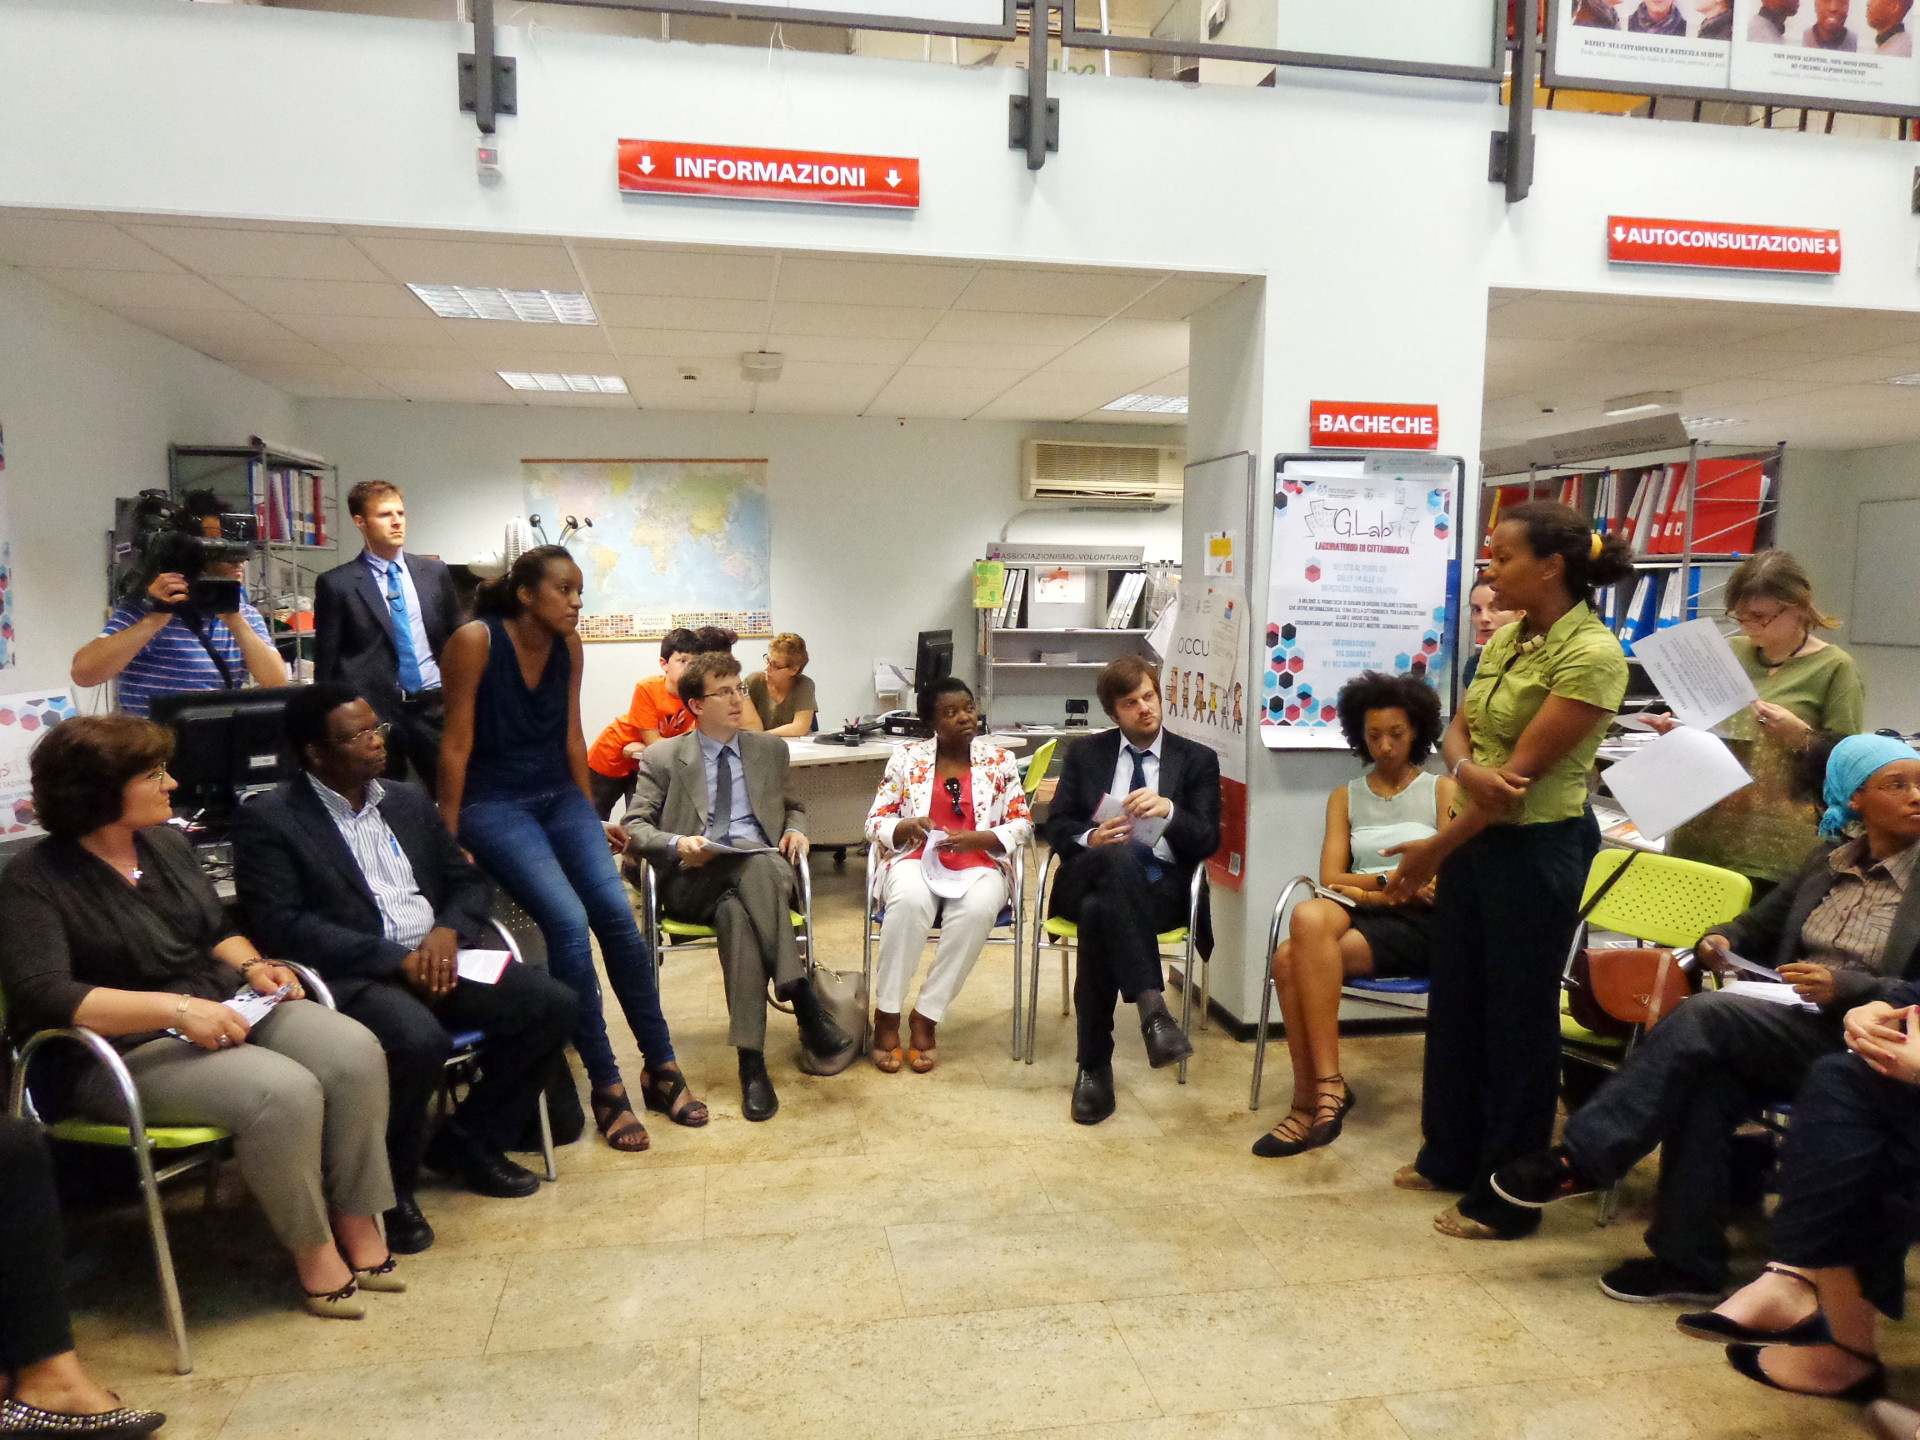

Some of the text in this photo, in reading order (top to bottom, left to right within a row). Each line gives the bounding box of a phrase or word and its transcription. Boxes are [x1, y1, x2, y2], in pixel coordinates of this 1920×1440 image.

[675, 157, 866, 187] INFORMAZIONI
[1627, 227, 1825, 253] AUTOCONSULTAZIONE
[1319, 414, 1433, 435] BACHECHE
[1001, 552, 1075, 560] ASSOCIAZIONISMO
[1079, 553, 1139, 561] VOLONTARIATO
